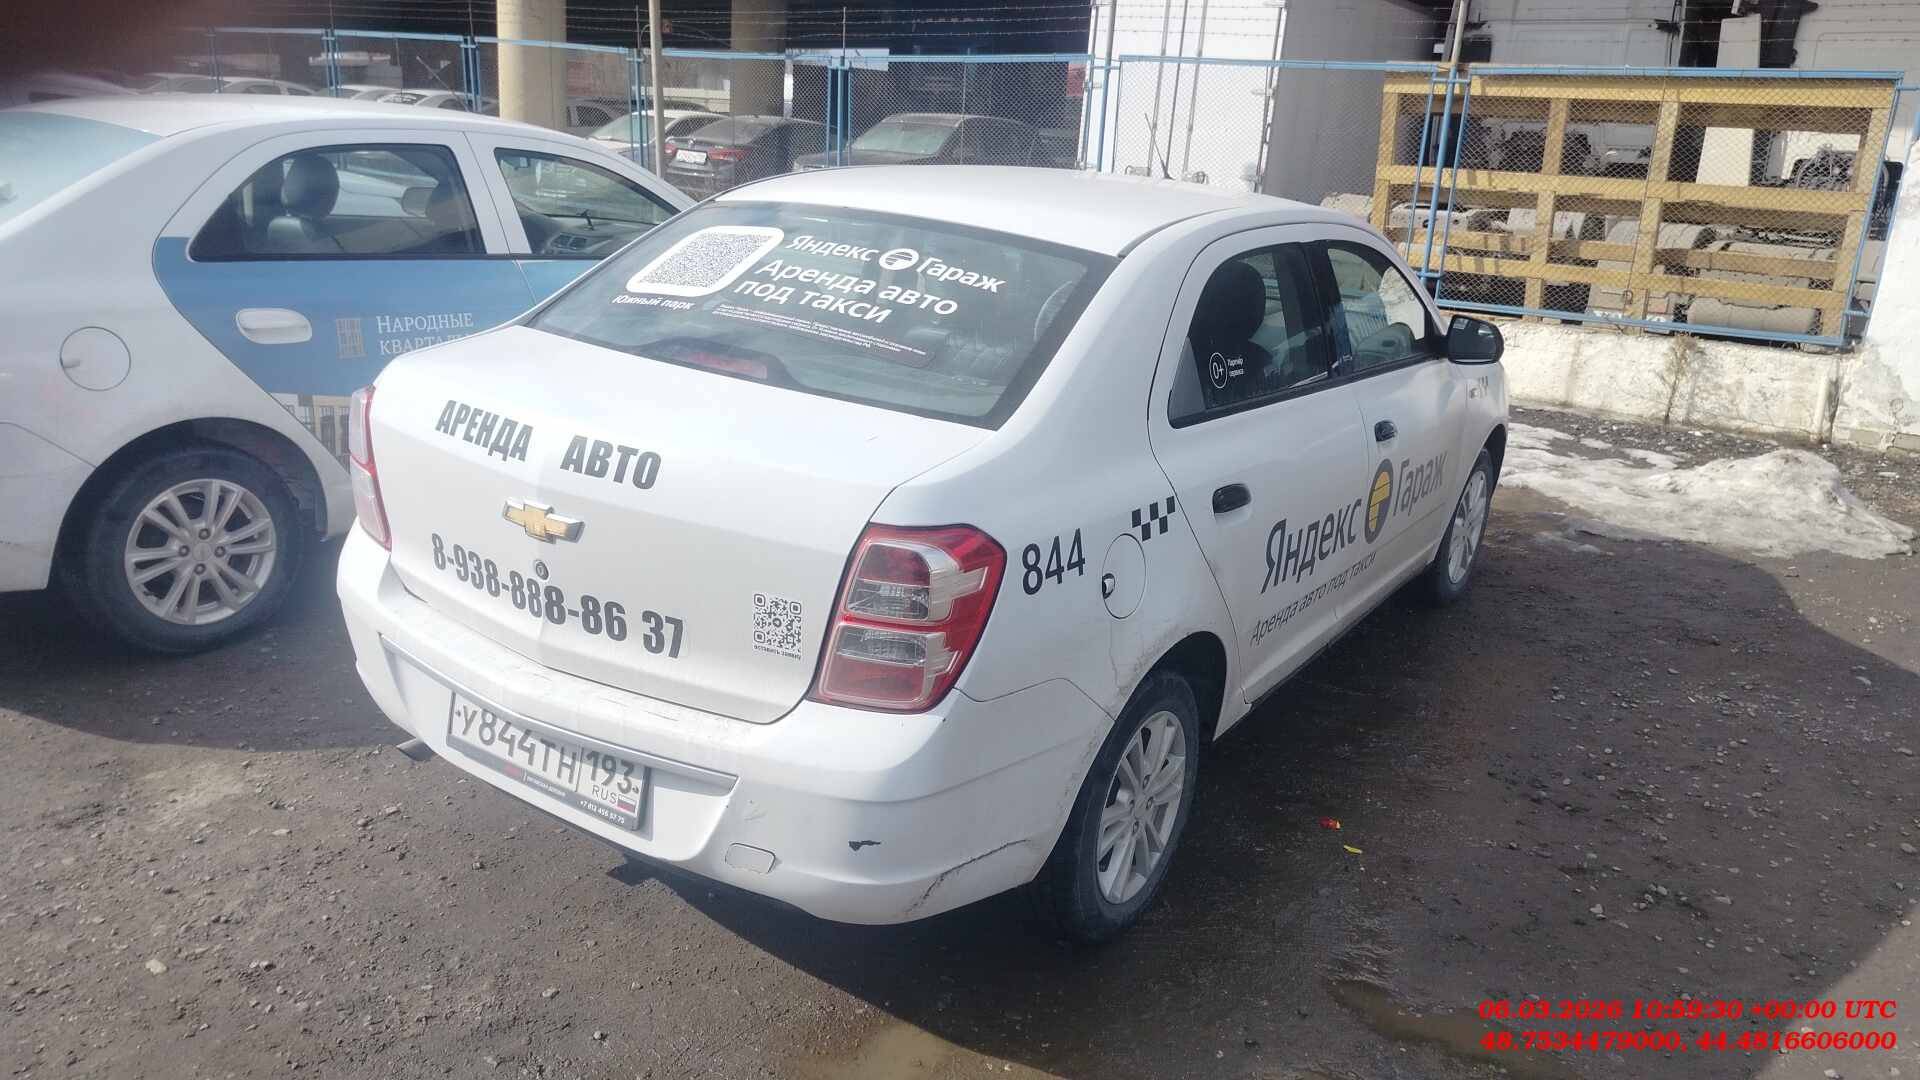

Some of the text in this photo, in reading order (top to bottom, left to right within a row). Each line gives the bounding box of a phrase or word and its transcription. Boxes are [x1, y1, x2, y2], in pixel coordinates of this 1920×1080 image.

[754, 258, 959, 316] Аренда авто
[787, 235, 1006, 294] Яндекс Гараж
[612, 294, 695, 311] Южный парк
[734, 279, 893, 324] под такси
[379, 334, 463, 355] КВАРТ
[435, 399, 662, 490] АРЕНДА АВТО
[1260, 452, 1448, 595] Яндекс Гараж
[1022, 527, 1086, 595] 844
[431, 533, 685, 659] 8-938-888-86 37
[1250, 552, 1377, 646] Аренда авто под такси
[461, 704, 636, 795] У844ТН 193
[592, 784, 617, 805] RUS
